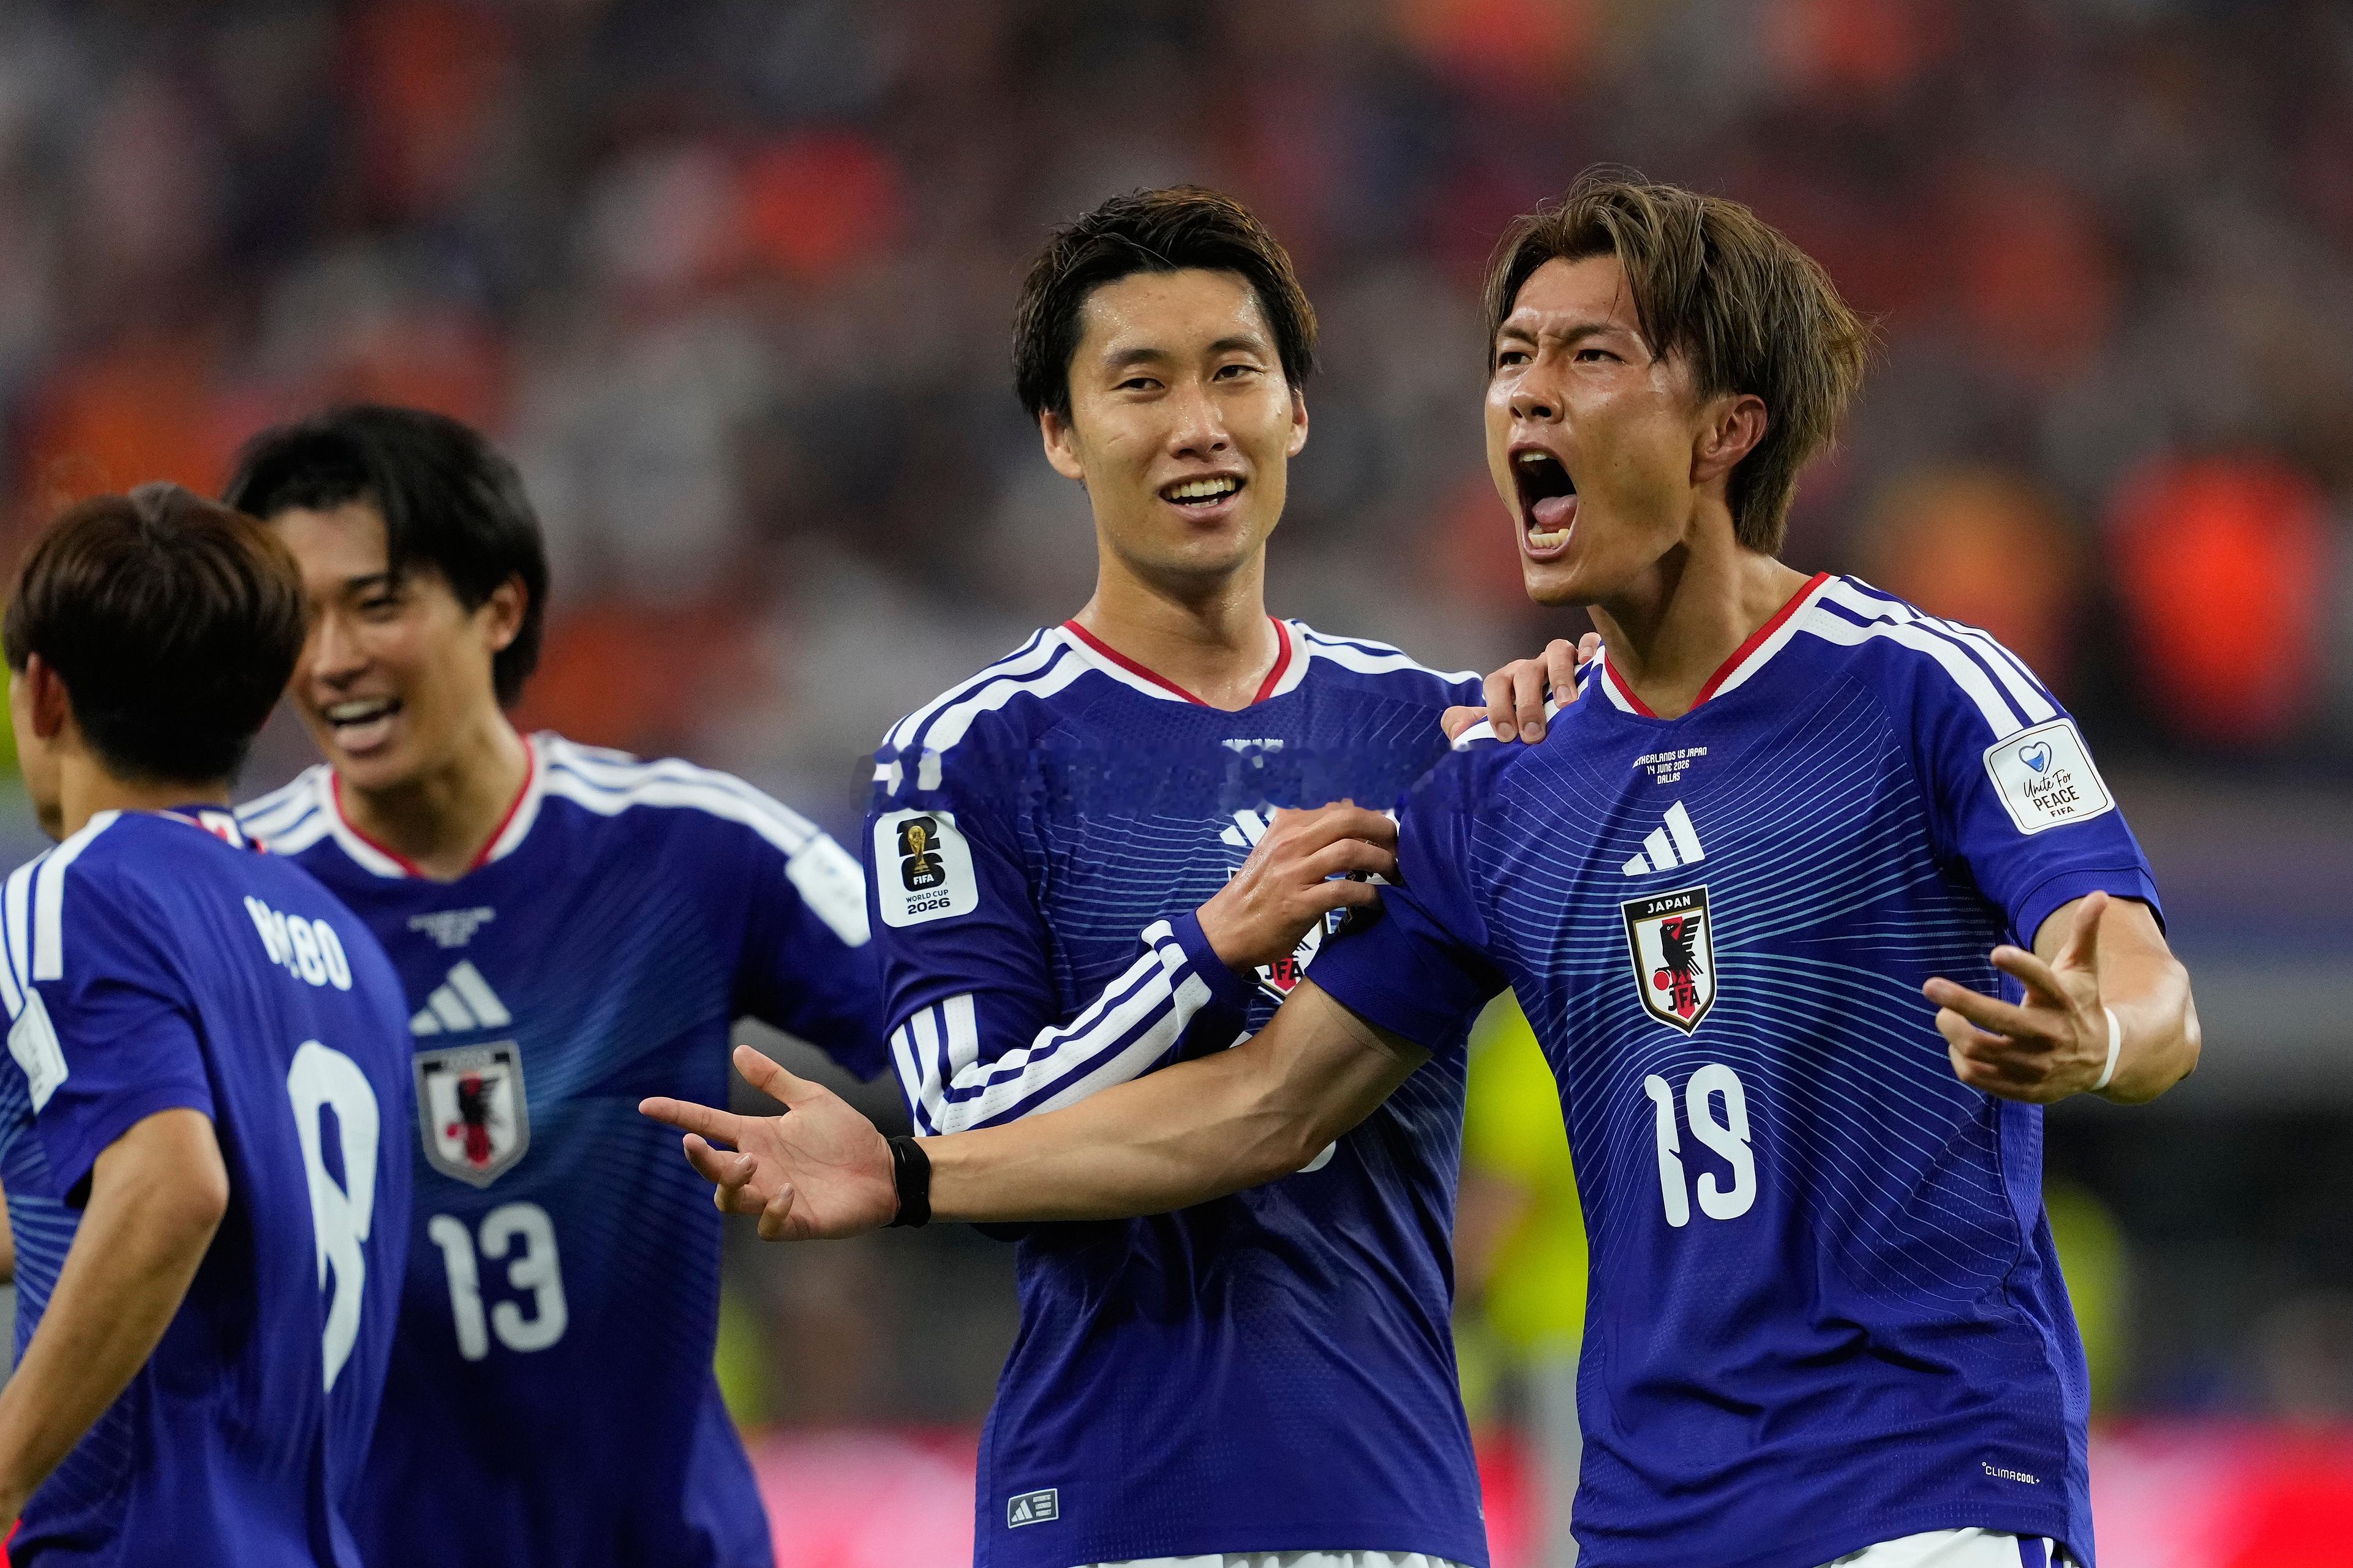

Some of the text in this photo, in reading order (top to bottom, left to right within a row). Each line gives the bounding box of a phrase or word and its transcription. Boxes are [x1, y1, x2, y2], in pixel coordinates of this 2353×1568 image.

[1632, 751, 1676, 769] THERLANDS
[1686, 746, 1707, 758] JAPAN
[1646, 759, 1690, 775] 14 JUNE 2026
[1657, 772, 1681, 785] DALLAS
[2024, 769, 2072, 798] Unite For
[2033, 785, 2080, 811] PEACE
[2050, 806, 2075, 817] FIFA
[913, 874, 935, 885] FIFA
[905, 889, 949, 903] WORLD CUP
[1647, 895, 1691, 914] JAPAN
[908, 898, 951, 915] 2026
[1265, 960, 1303, 980] JFA
[1668, 985, 1701, 1011] JFA
[1644, 1063, 1756, 1228] 19
[429, 1201, 569, 1362] 13
